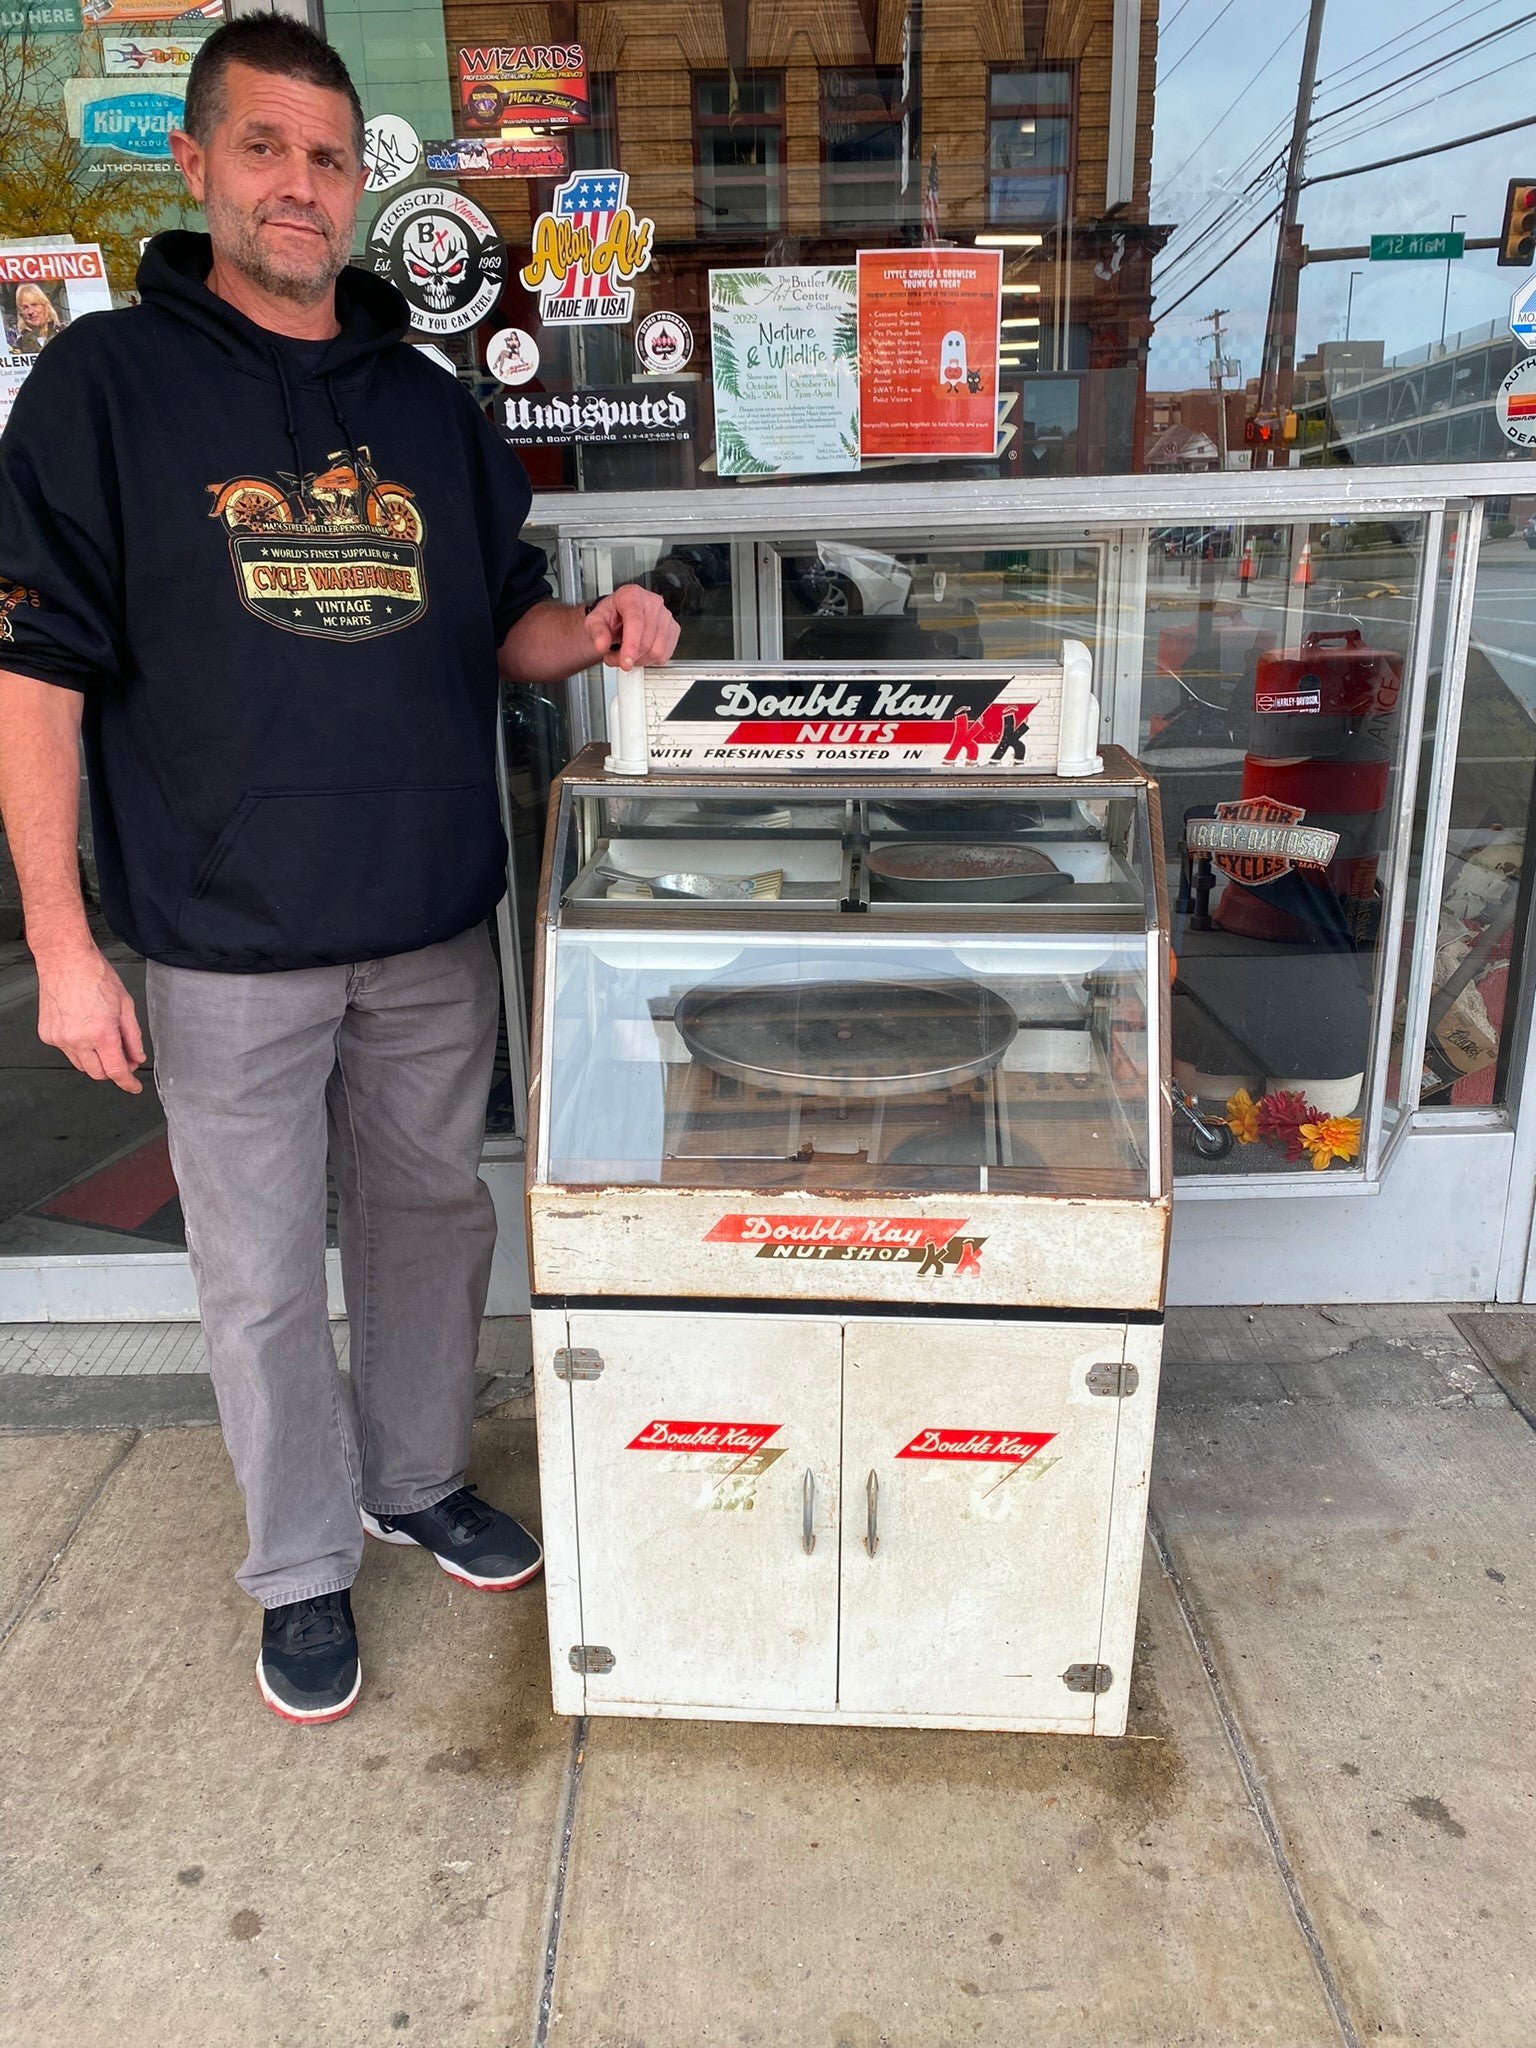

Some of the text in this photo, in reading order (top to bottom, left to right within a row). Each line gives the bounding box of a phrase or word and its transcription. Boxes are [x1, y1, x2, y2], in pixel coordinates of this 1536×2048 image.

[0, 8, 75, 25] LD HERE
[460, 44, 583, 73] WIZARDS
[94, 109, 185, 137] Küryak
[88, 163, 171, 172] AUTHORIZED
[523, 209, 650, 286] Alloy Art
[0, 253, 97, 281] ARCHING
[374, 256, 502, 272] Est 1969
[791, 275, 826, 288] Butler
[884, 270, 976, 280] LITTLE GHOULS & GROWLERS
[903, 280, 961, 288] TRUNK OR TREAT
[792, 289, 830, 301] Center
[428, 318, 447, 330] YOU
[451, 312, 471, 328] CAN
[470, 294, 492, 317] FEEL
[546, 298, 626, 318] MADE IN USA
[734, 314, 758, 324] 2022
[759, 322, 816, 346] Nature
[747, 343, 827, 369] & Wildlife
[790, 379, 836, 388] October 7th
[1504, 359, 1536, 391] AUTH
[746, 381, 778, 390] October
[504, 390, 687, 435] Undisputed
[536, 436, 544, 444] &
[1507, 426, 1536, 444] DEA
[271, 548, 391, 560] WORLD'S FINEST SUPPLIER OF
[253, 566, 414, 593] CYCLE WAREHOUSE
[316, 600, 373, 614] VINTAGE
[323, 616, 372, 626] MC PARTS
[715, 683, 955, 720] Double Kay
[795, 722, 900, 743] NUTS
[650, 748, 922, 760] WITH FRESHNESS TOASTED IN
[1221, 802, 1293, 825] MOTOR
[1217, 853, 1290, 881] CYCLES
[740, 1217, 923, 1244] Double Kay
[772, 1244, 910, 1261] NUT SHOP
[639, 1422, 764, 1450] Double Kay
[910, 1430, 1038, 1458] Double Kay
